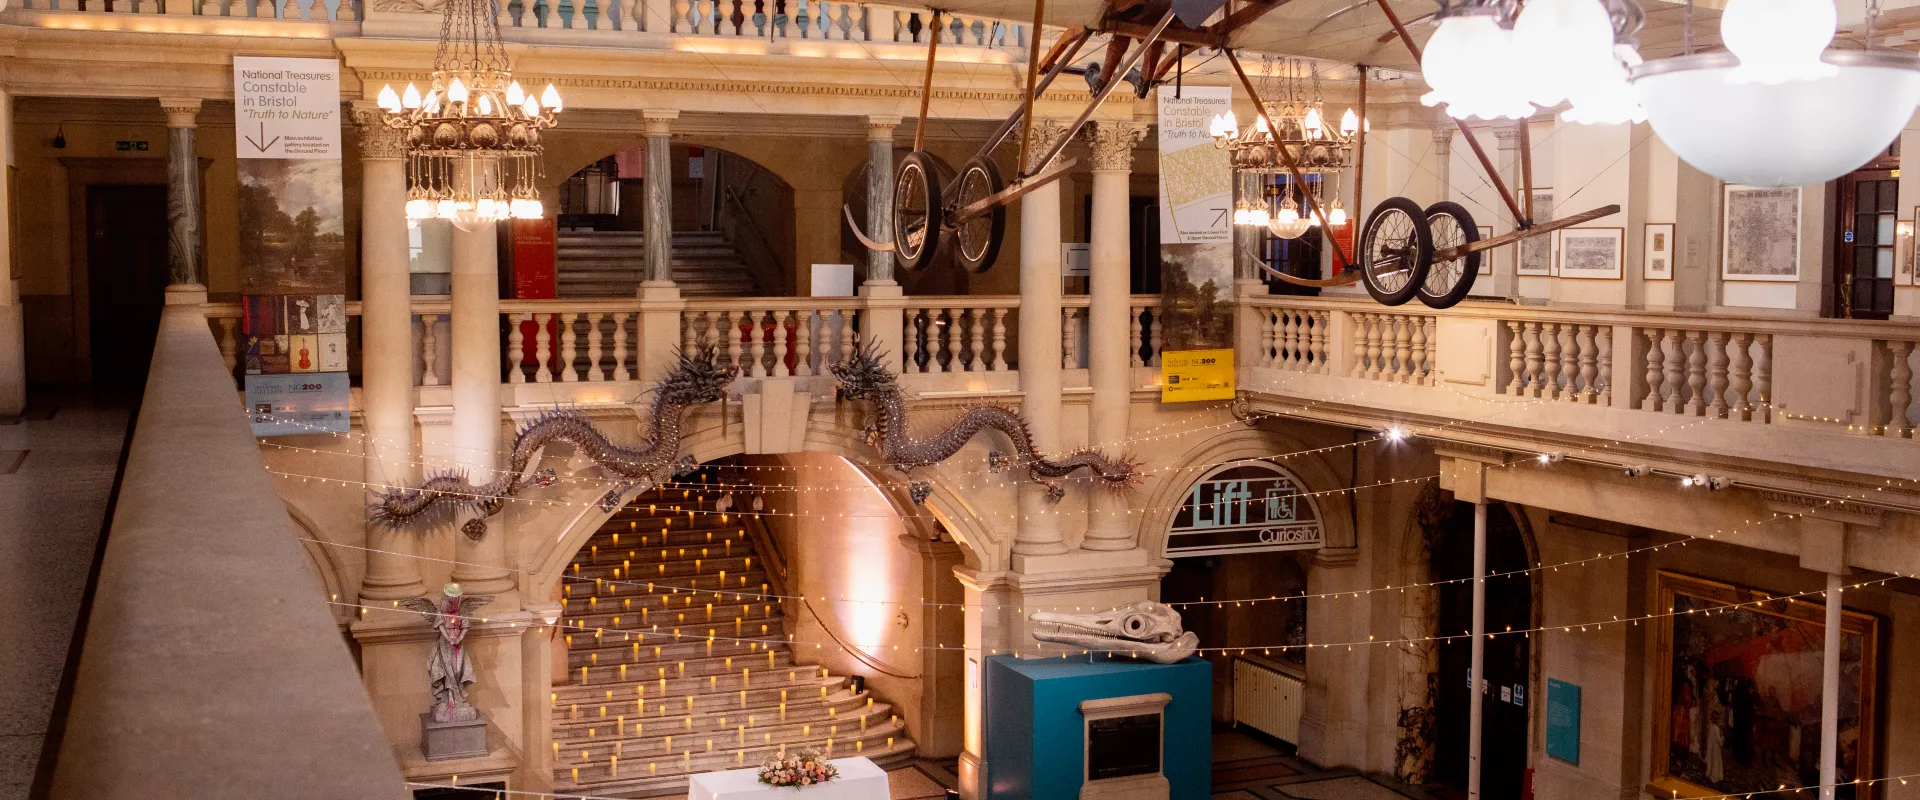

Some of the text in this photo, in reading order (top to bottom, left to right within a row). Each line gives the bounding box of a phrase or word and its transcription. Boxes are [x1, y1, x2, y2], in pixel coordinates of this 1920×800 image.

[242, 70, 334, 80] National Treasures:
[243, 81, 307, 93] Constable
[243, 95, 297, 107] in Bristol
[1163, 96, 1192, 104] National
[279, 110, 289, 119] to
[1163, 106, 1211, 116] Constable
[1164, 117, 1204, 128] in Bristol
[1188, 131, 1197, 139] to
[1193, 479, 1252, 528] Lift
[1259, 526, 1318, 544] Curiosity
